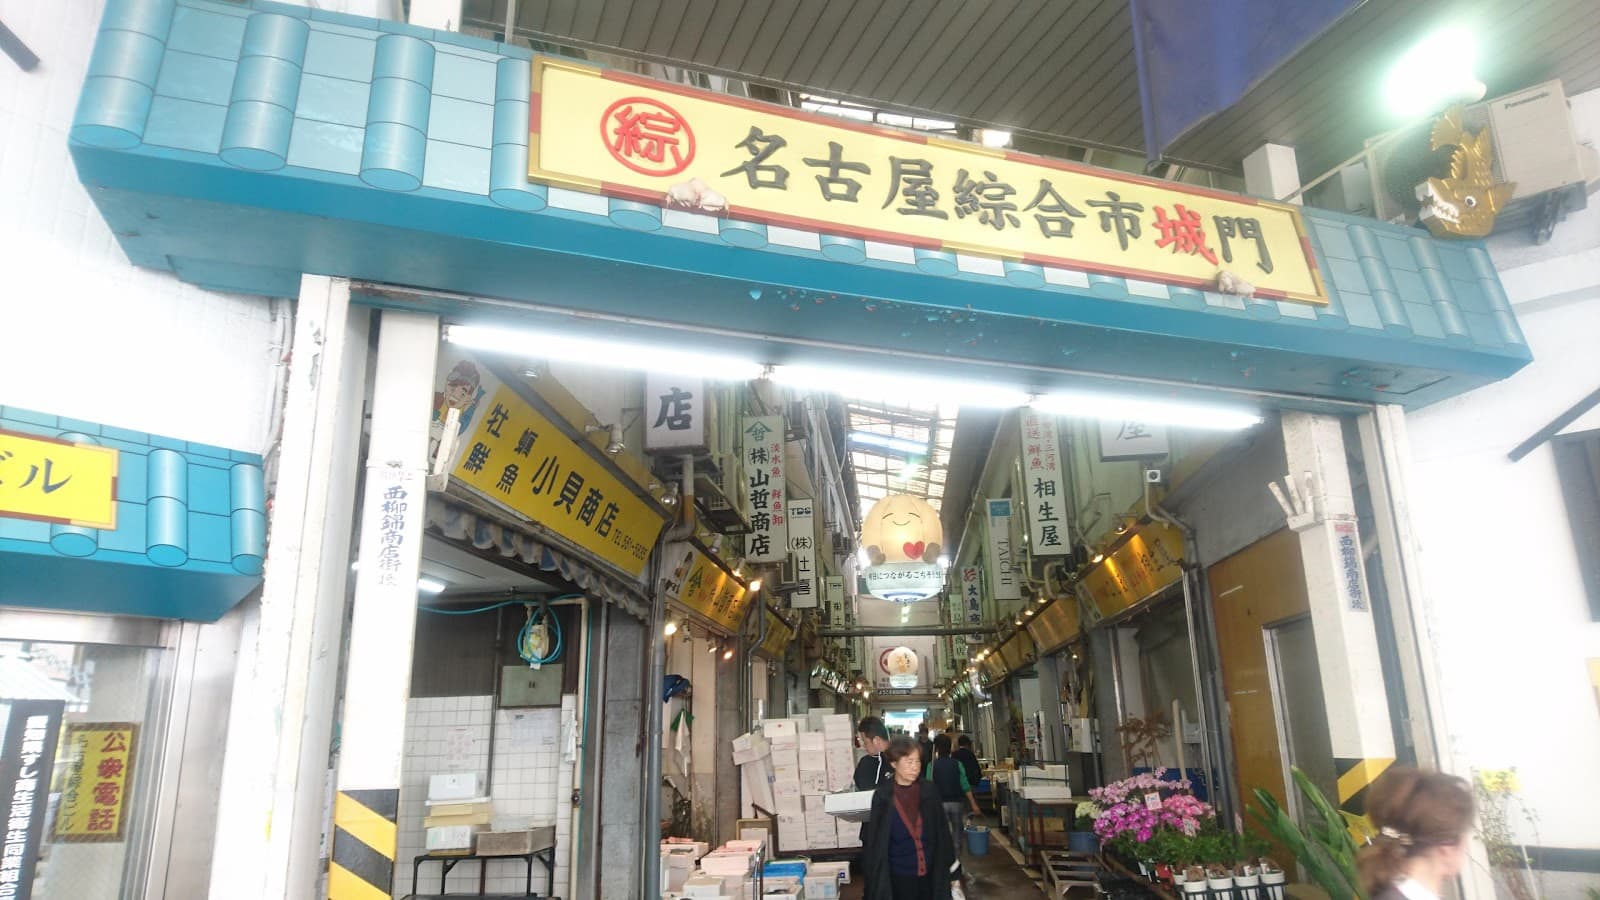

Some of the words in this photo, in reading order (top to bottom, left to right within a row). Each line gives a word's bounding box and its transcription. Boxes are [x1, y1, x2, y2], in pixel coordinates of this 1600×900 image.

[719, 125, 1274, 274] 名古屋綜合市城門
[653, 387, 693, 431] 店
[0, 450, 73, 494] ル
[462, 441, 520, 495] 鮮魚
[531, 455, 620, 539] 小貝商店
[1033, 478, 1062, 547] 相生屋
[87, 732, 127, 831] 公衆電話
